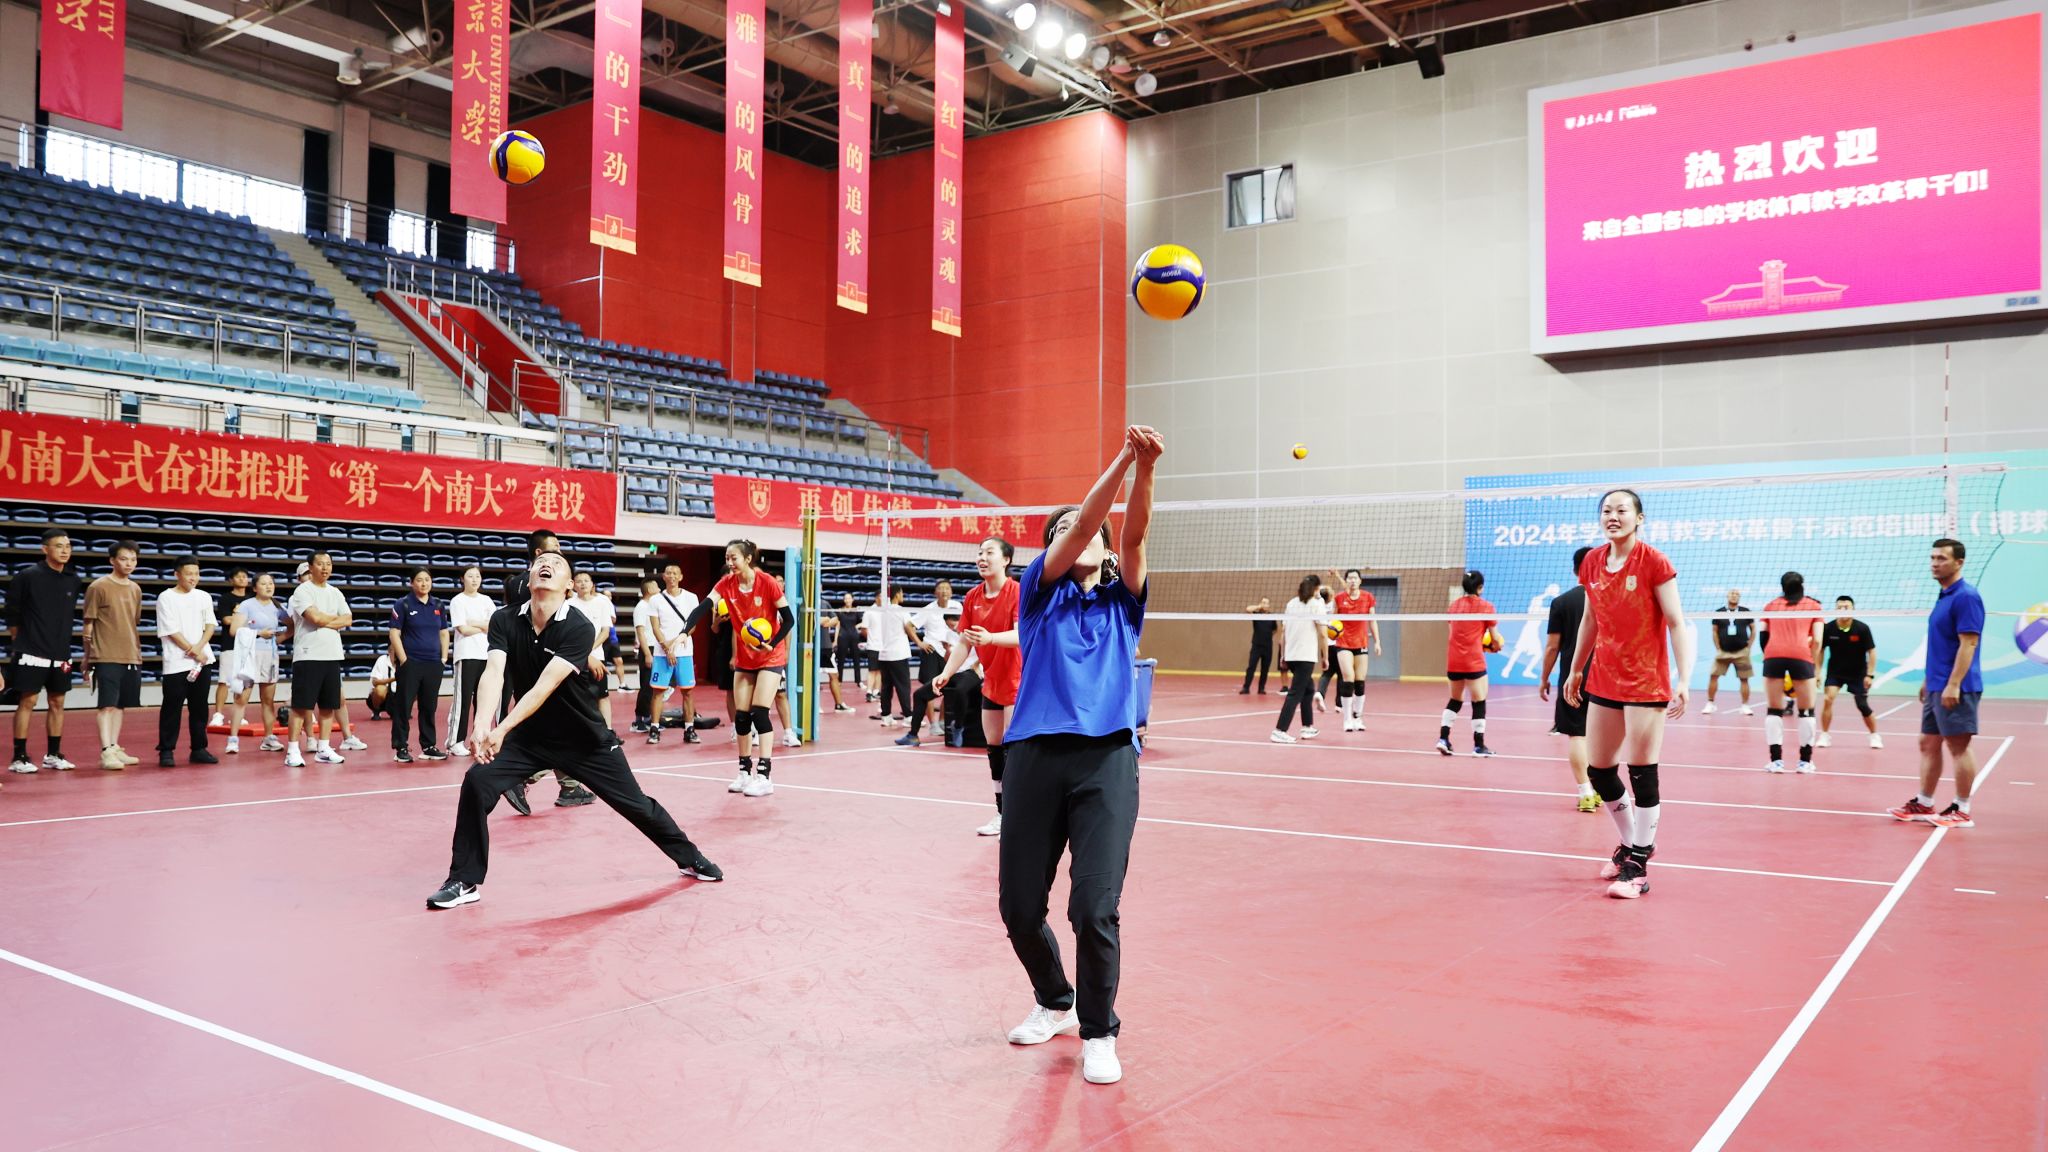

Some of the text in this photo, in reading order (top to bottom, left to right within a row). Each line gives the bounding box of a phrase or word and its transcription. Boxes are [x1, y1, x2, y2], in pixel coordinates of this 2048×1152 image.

[1684, 126, 1880, 189] 热烈欢迎
[652, 672, 659, 683] 8
